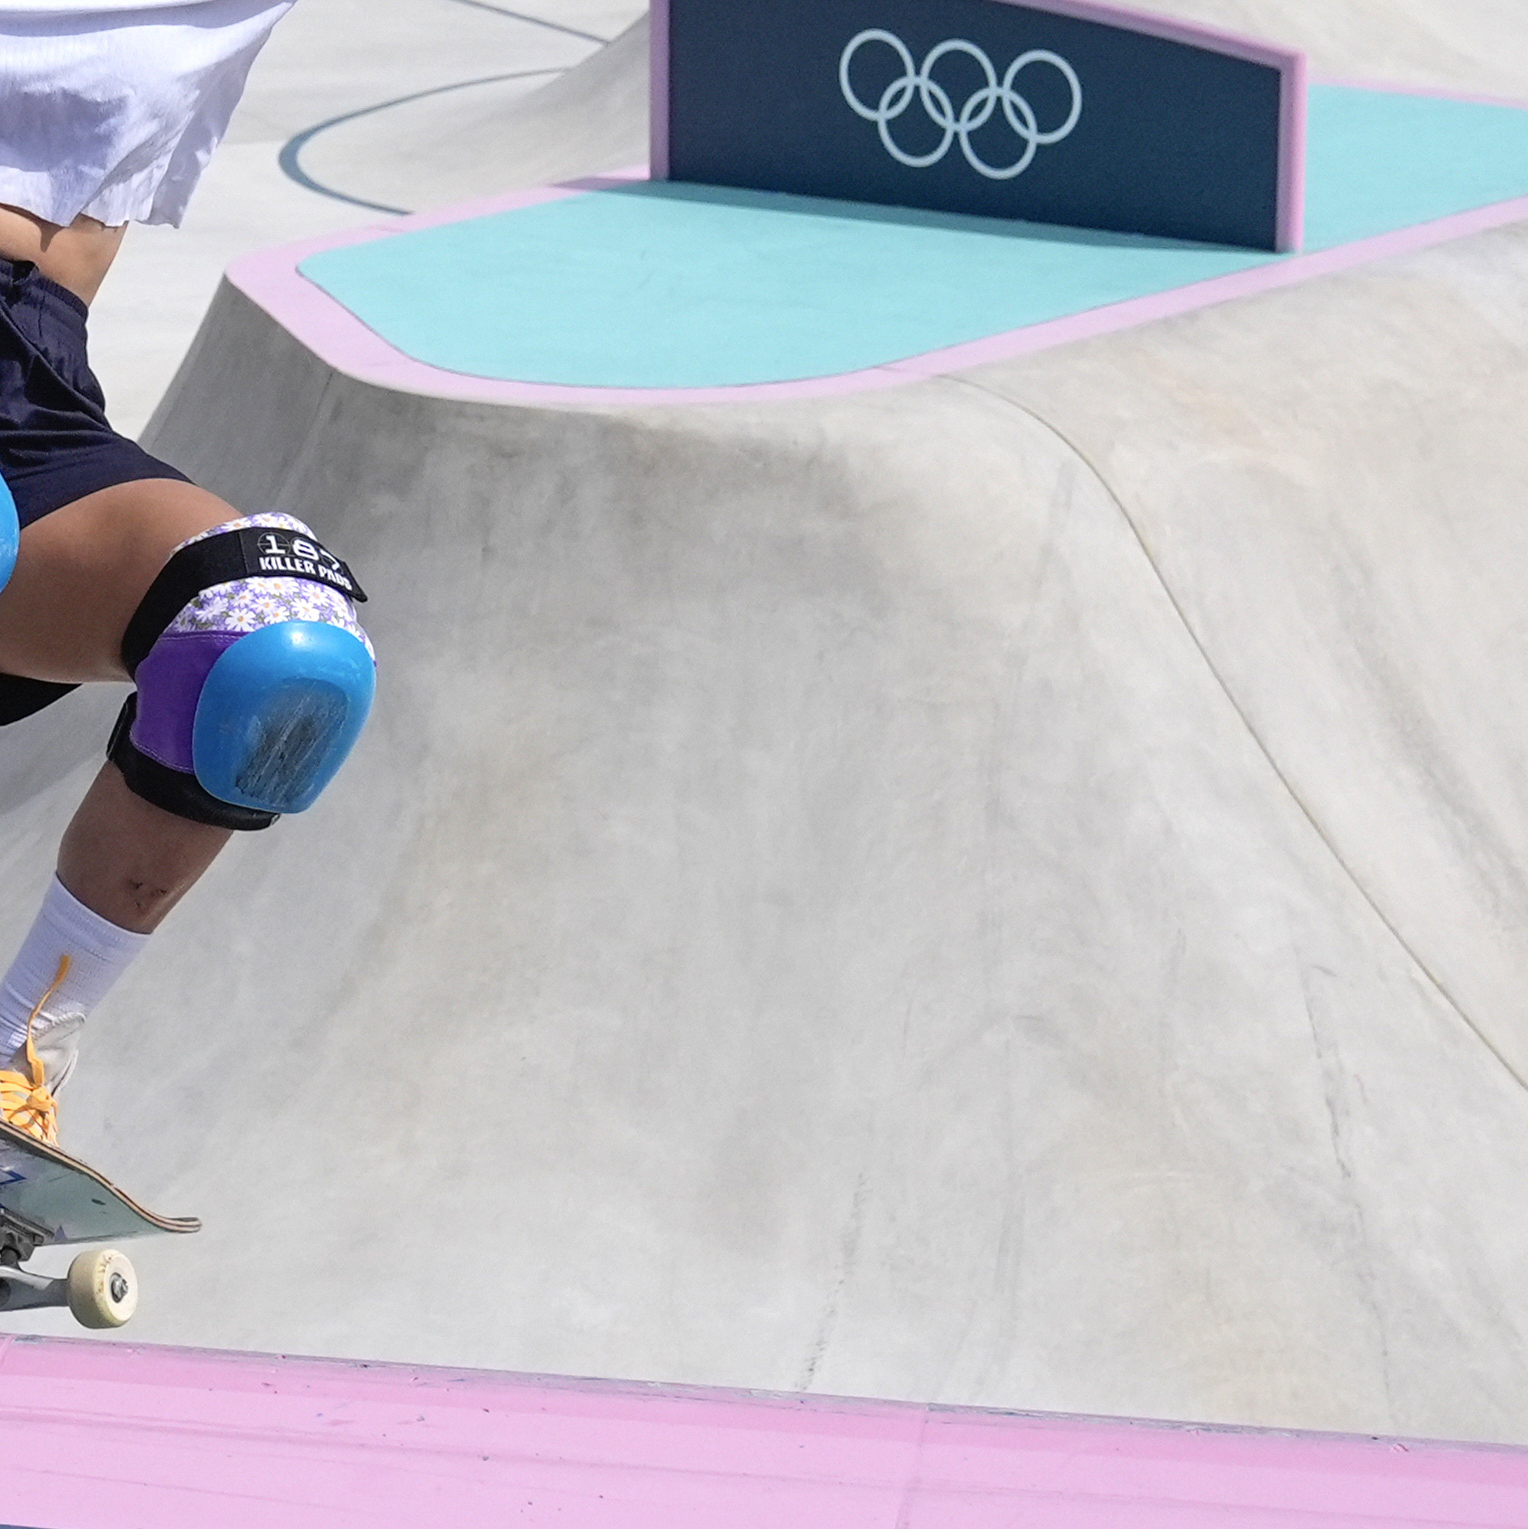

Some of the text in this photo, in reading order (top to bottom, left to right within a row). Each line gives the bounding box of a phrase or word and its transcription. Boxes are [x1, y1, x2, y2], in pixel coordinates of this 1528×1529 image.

[263, 534, 341, 571] 187
[259, 557, 353, 591] KILLER PADS
